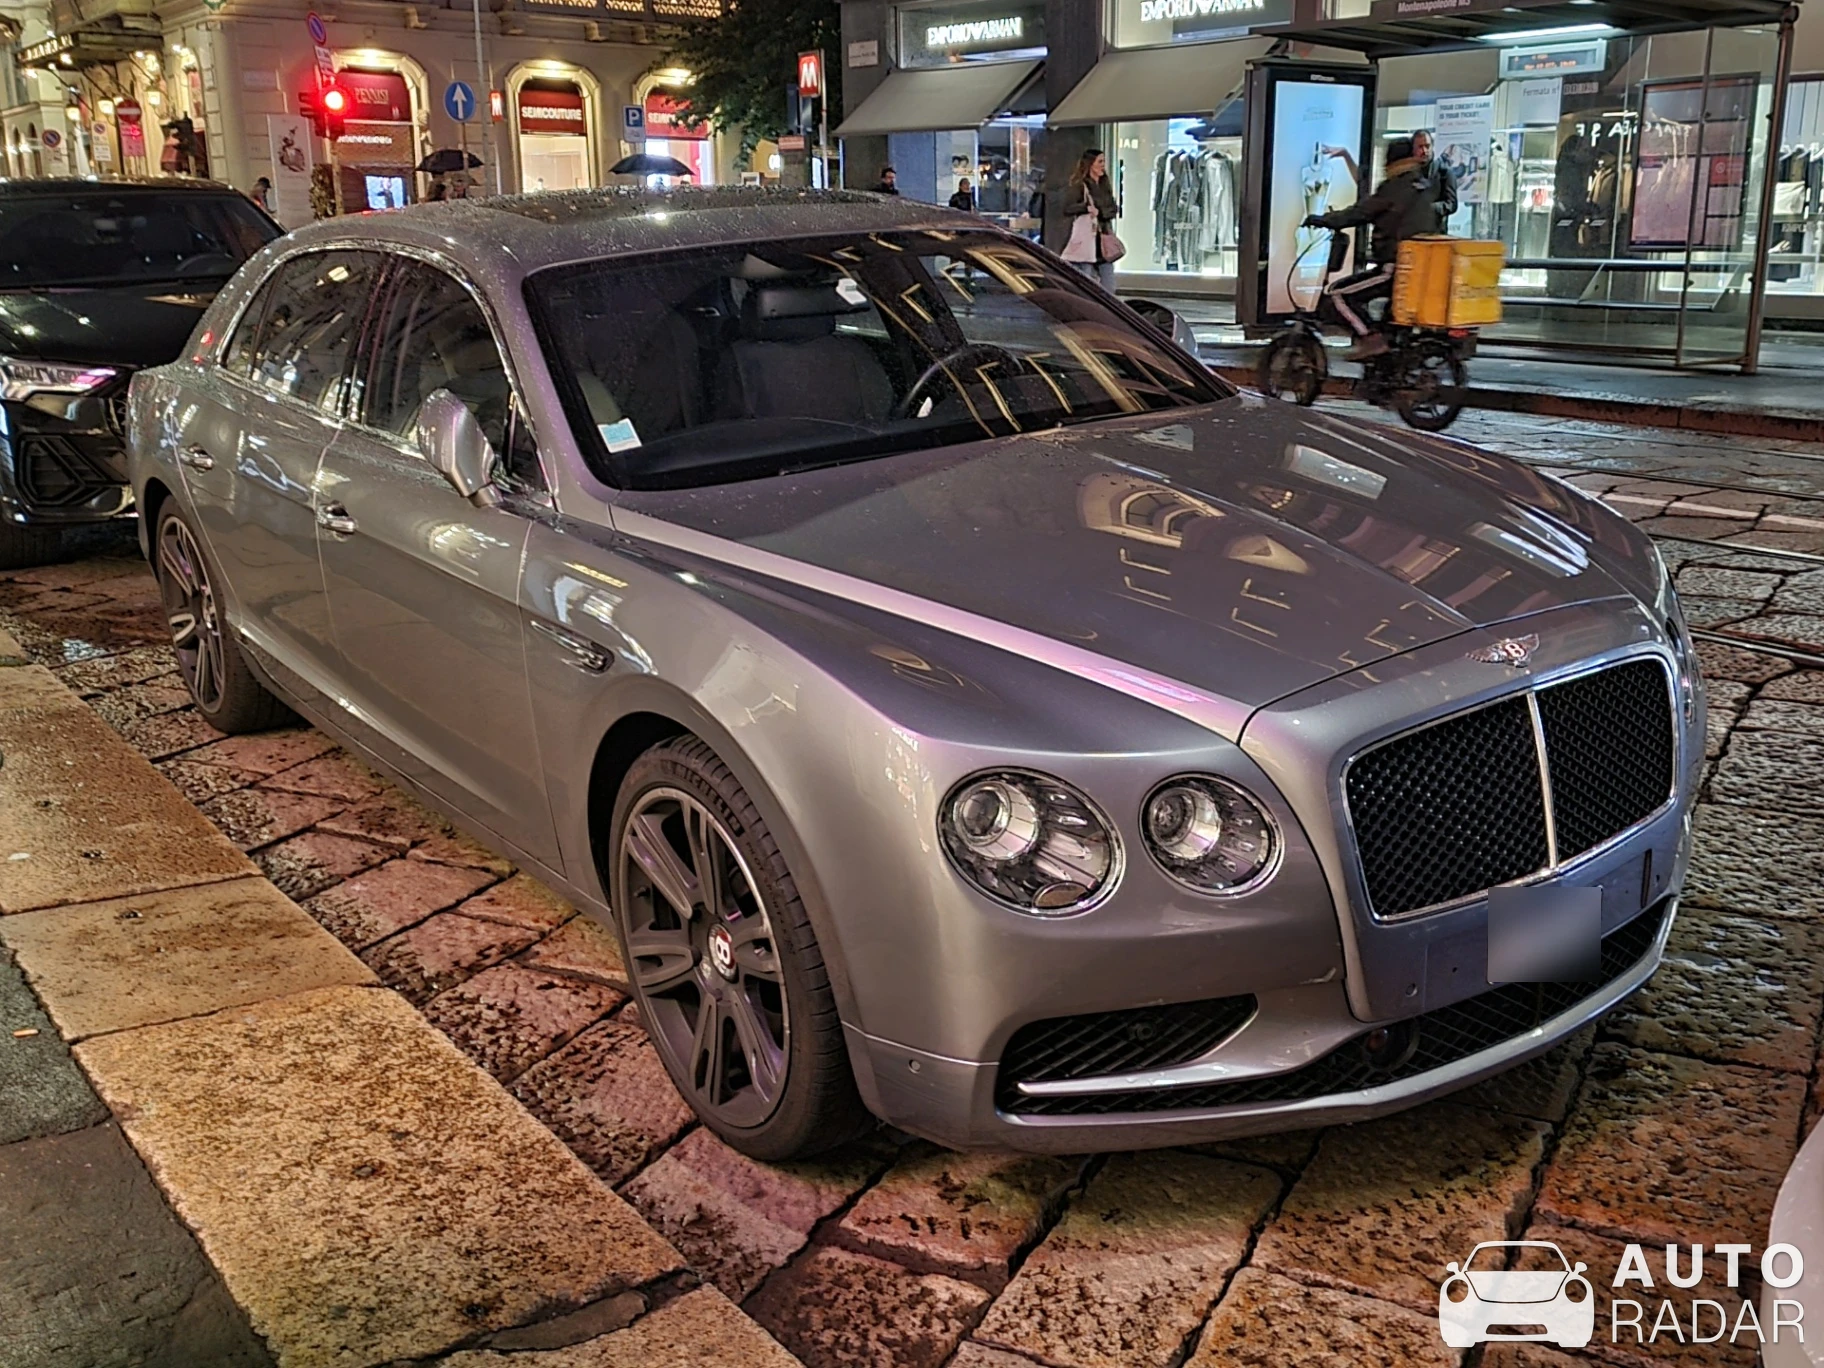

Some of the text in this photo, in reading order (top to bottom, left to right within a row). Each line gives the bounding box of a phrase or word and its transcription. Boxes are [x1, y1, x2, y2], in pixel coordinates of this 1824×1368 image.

[1140, 0, 1198, 21] EMPORIO
[1398, 0, 1457, 13] Montenapoleone
[800, 60, 818, 88] M
[521, 106, 582, 120] SEMICOUTURE
[628, 109, 640, 125] P
